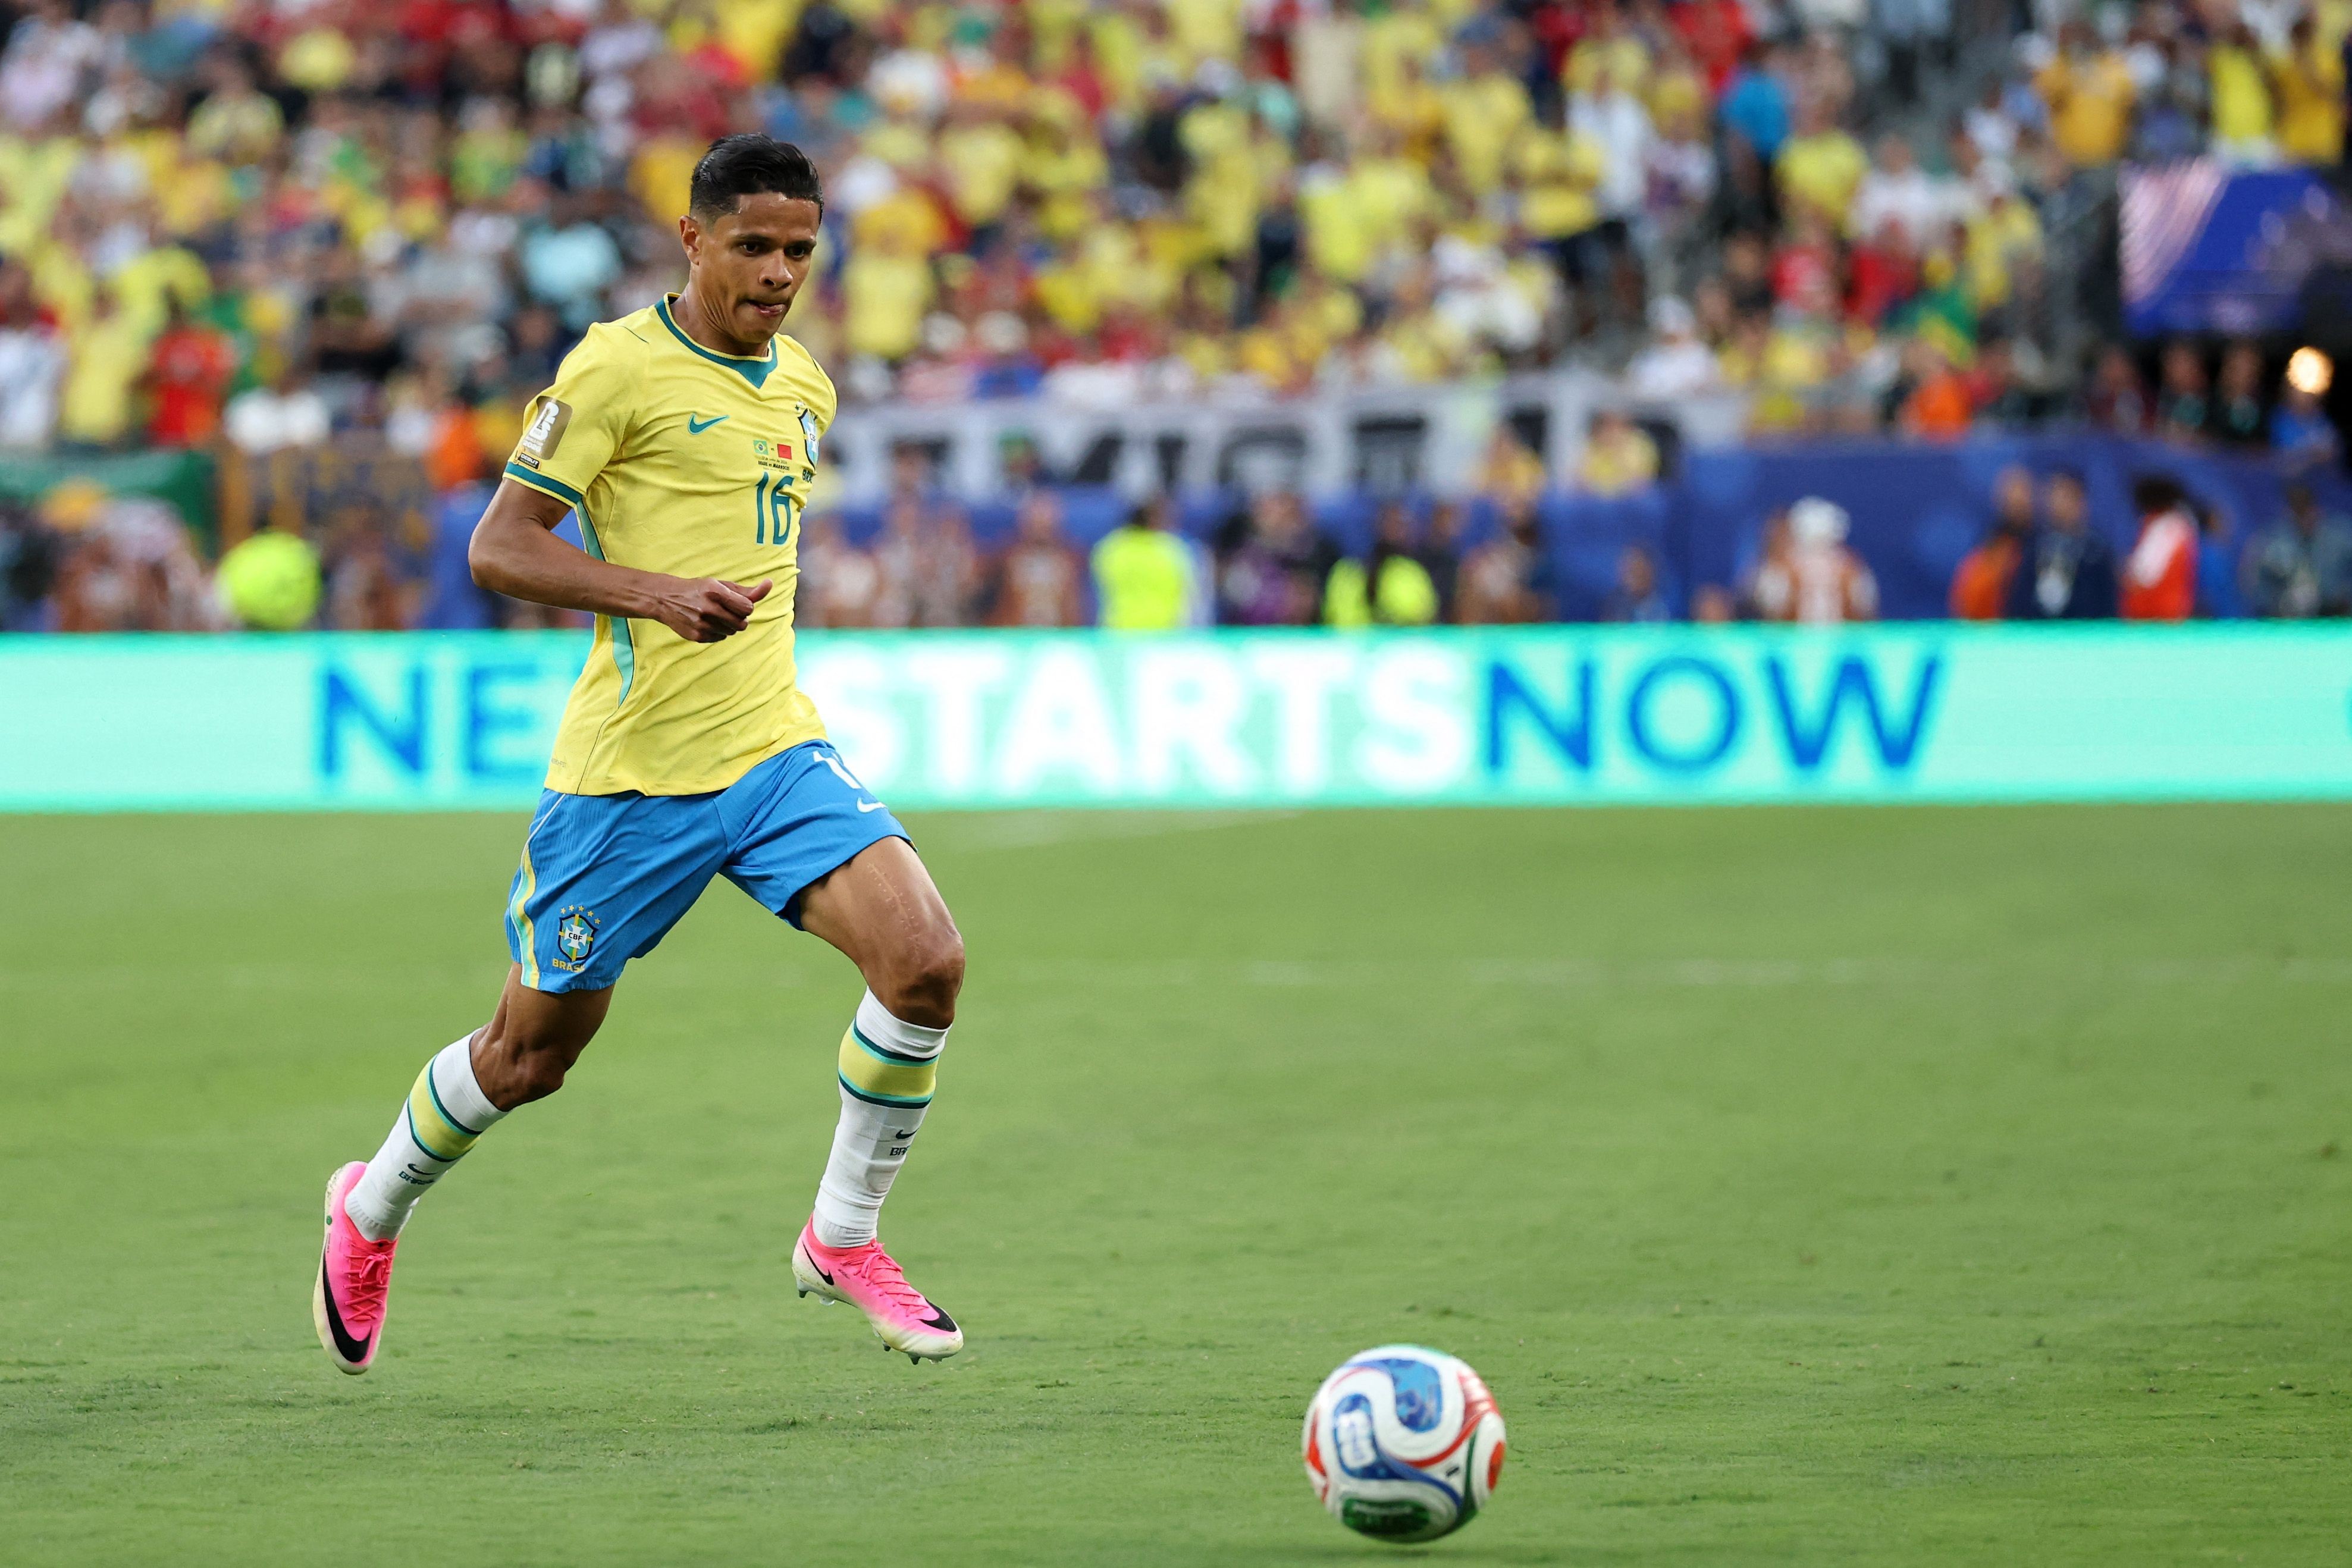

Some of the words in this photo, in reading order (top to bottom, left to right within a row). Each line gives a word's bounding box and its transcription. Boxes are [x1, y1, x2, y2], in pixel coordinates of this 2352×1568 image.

[520, 453, 539, 465] DEBUT
[755, 472, 795, 545] 16
[800, 645, 1468, 791] STARTS
[1480, 656, 1946, 771] NOW
[812, 749, 862, 789] 1
[568, 932, 583, 941] CBF
